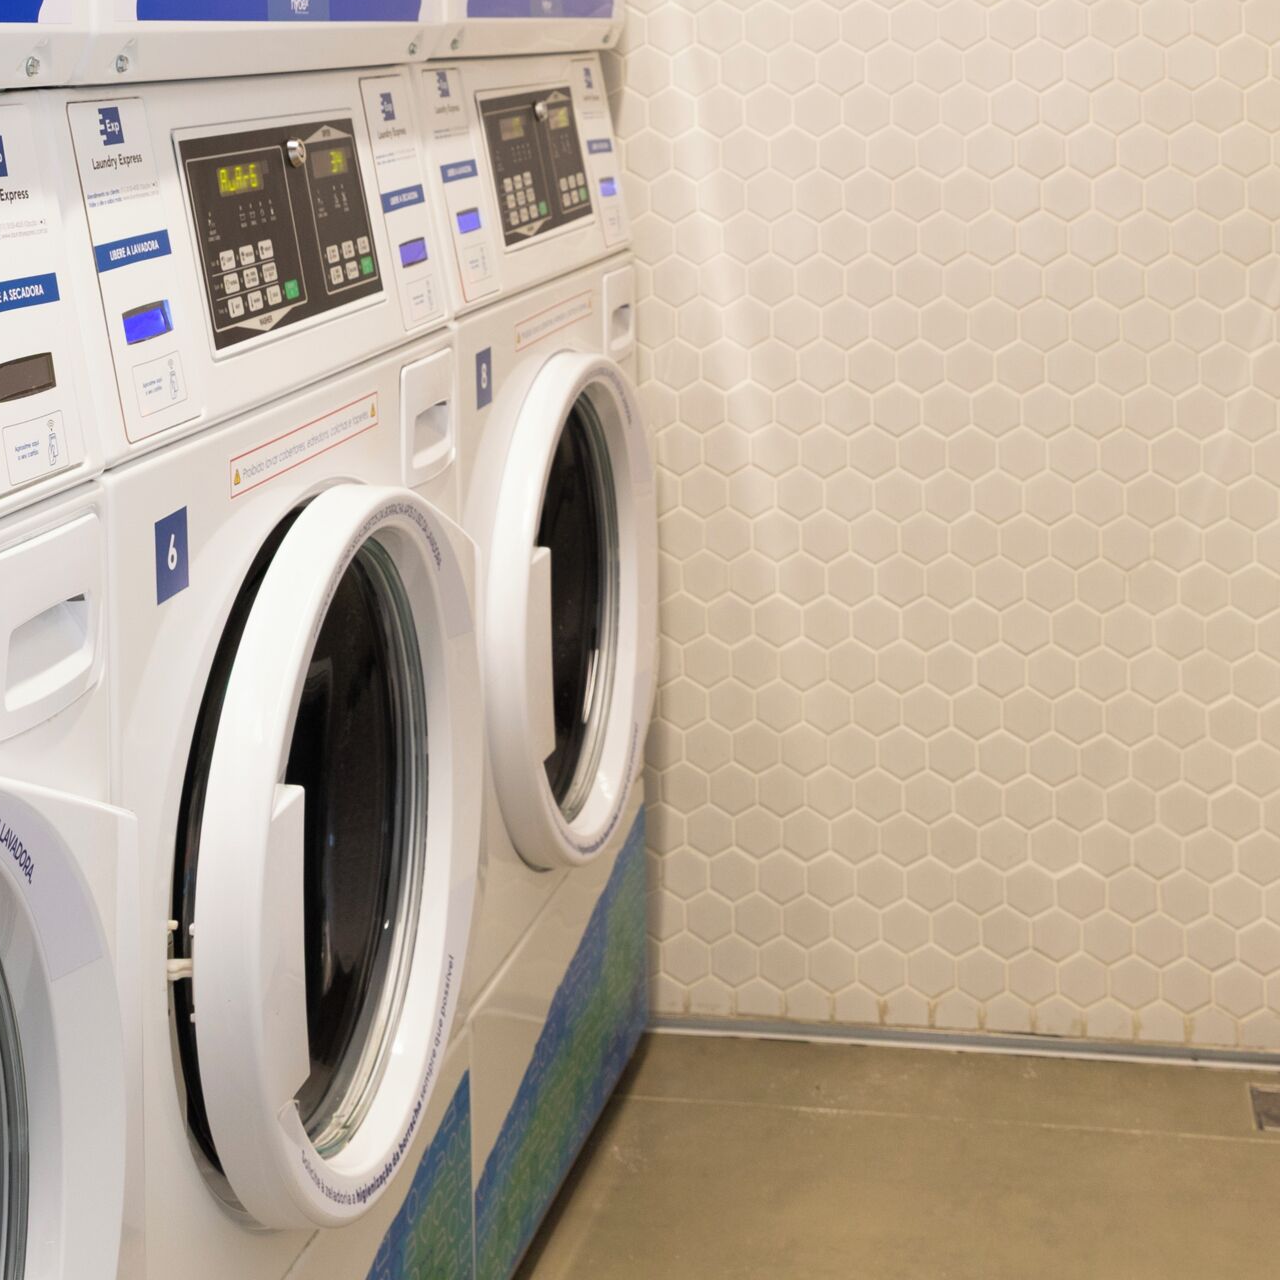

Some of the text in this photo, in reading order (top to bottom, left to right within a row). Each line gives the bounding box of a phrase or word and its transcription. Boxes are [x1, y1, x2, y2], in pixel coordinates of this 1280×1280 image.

[105, 119, 120, 135] Exp
[91, 153, 143, 170] Laundry Express
[0, 188, 30, 205] Express
[3, 290, 9, 301] A
[8, 284, 45, 300] SECADORA
[481, 363, 488, 389] 8
[167, 533, 178, 571] 6
